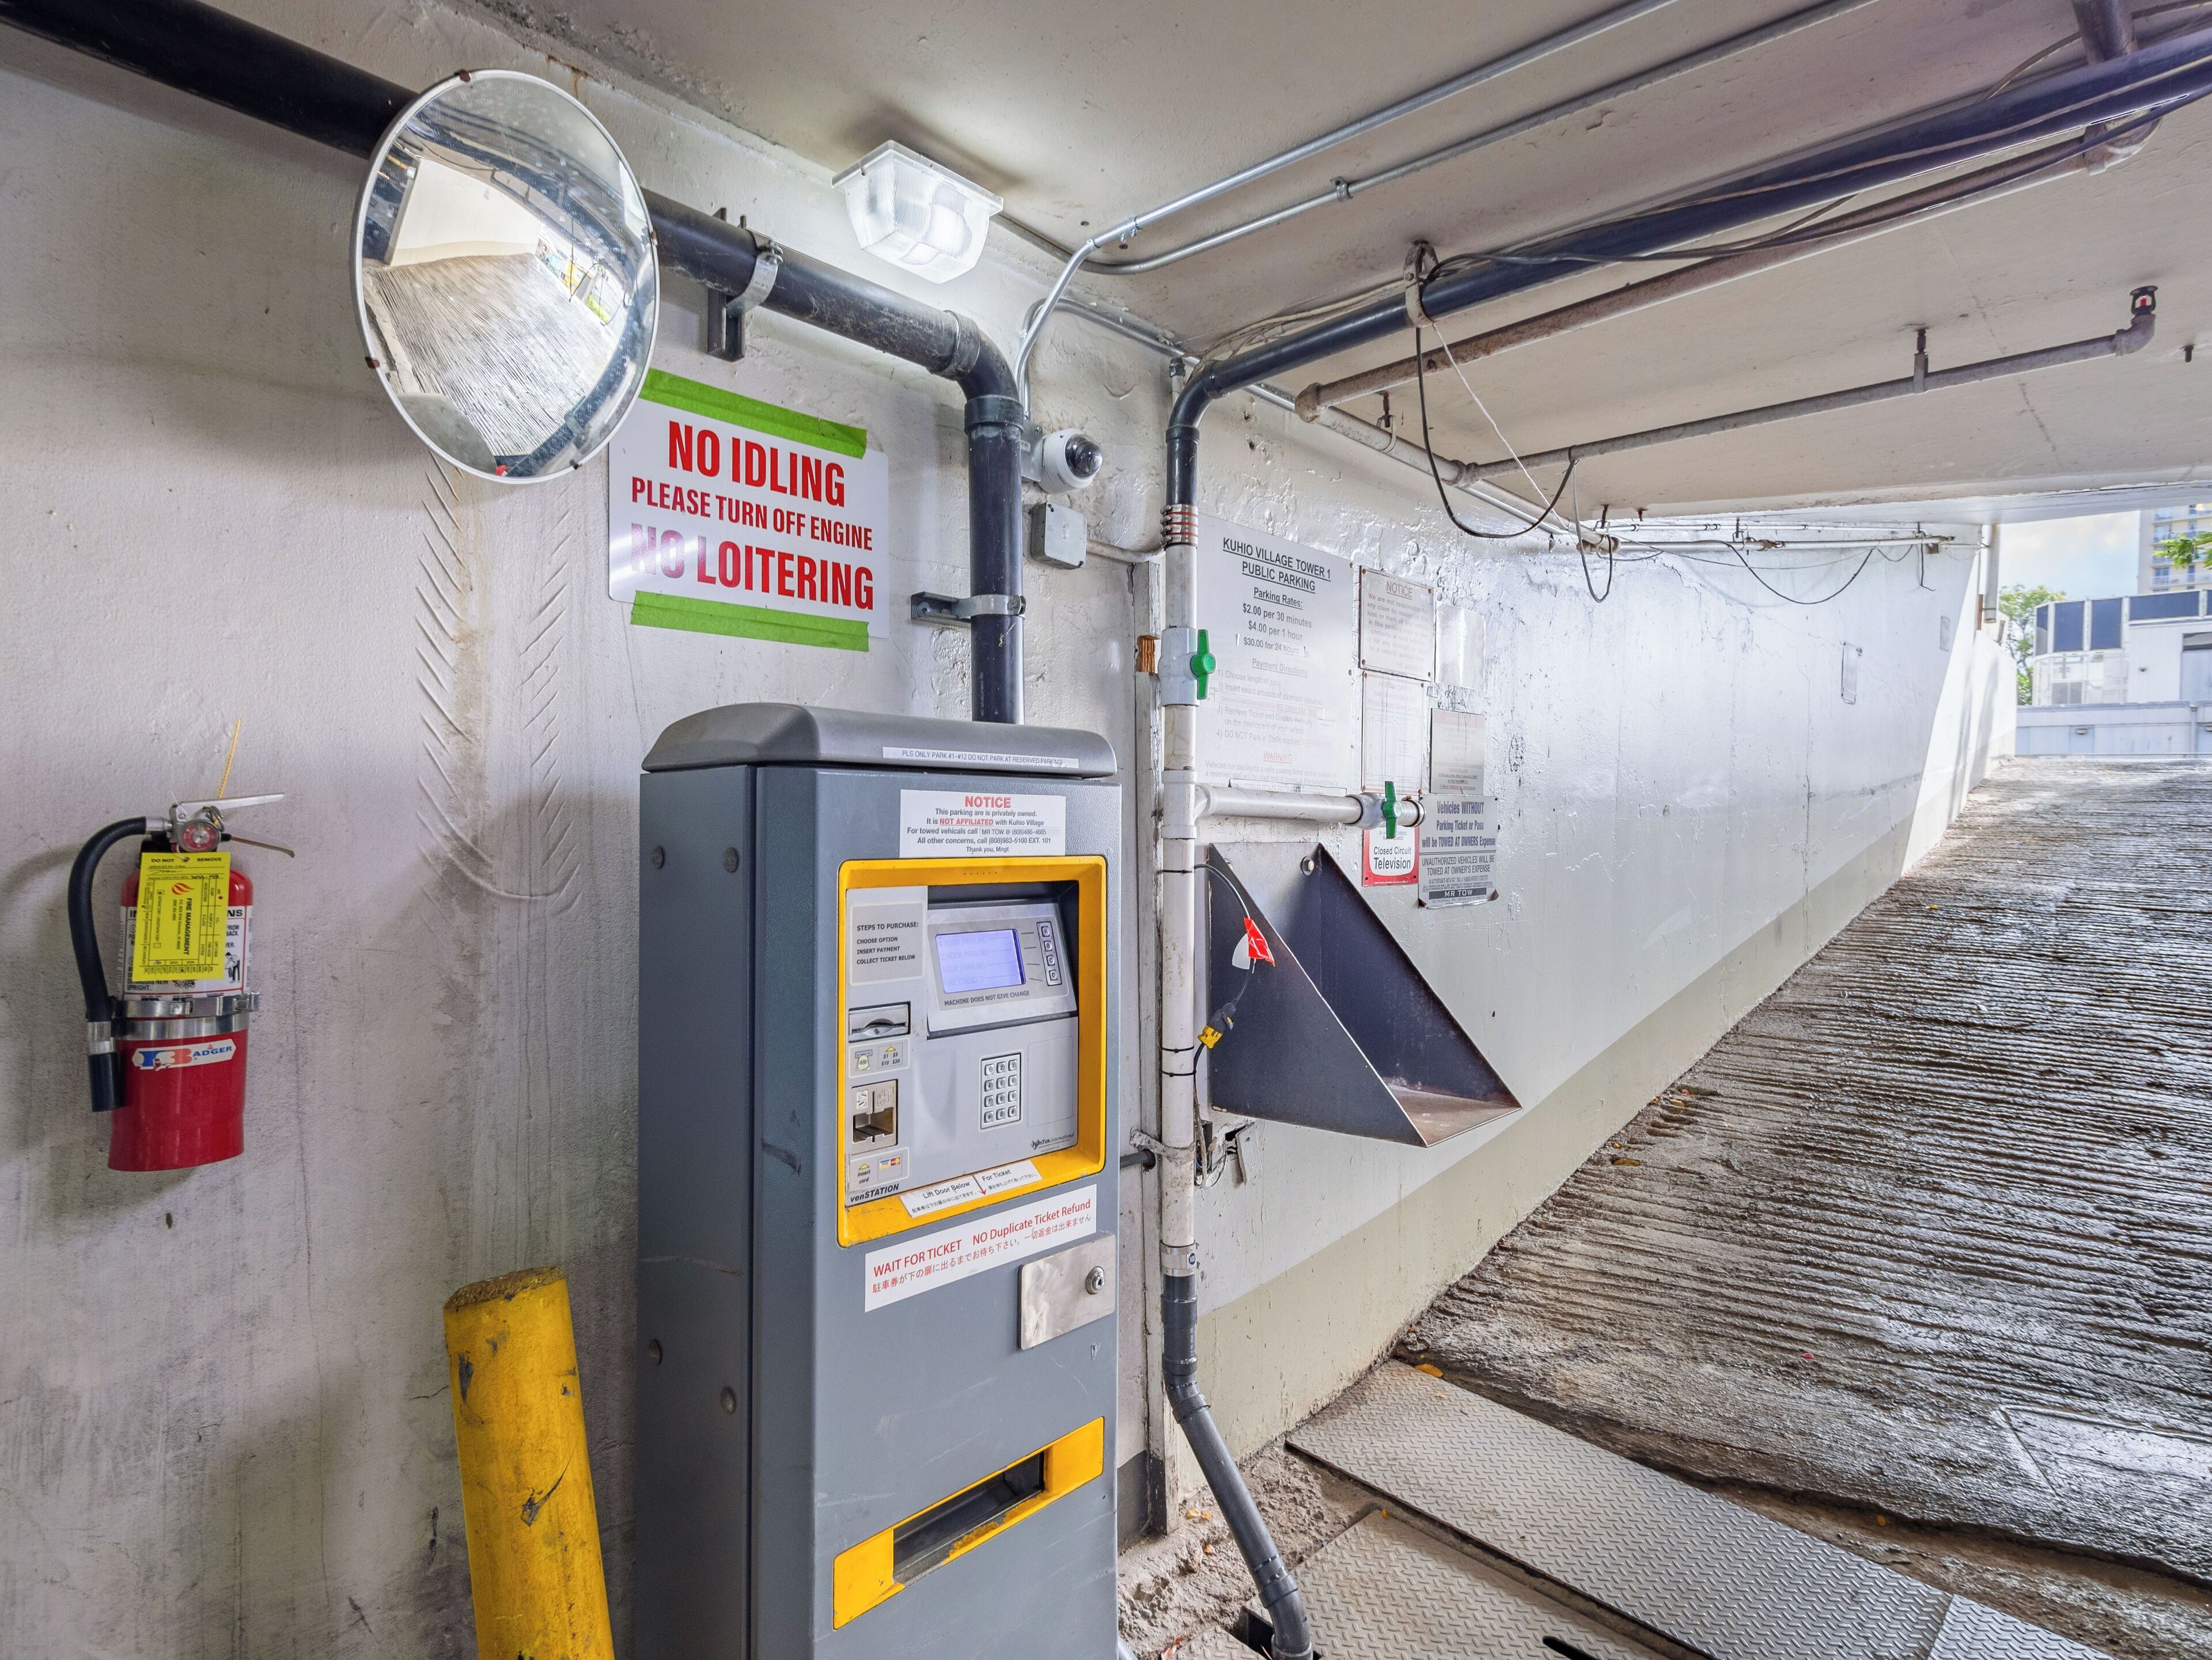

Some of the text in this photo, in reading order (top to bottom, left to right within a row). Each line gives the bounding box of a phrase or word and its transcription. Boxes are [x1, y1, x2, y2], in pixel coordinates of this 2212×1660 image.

[669, 422, 844, 506] NO IDLING
[632, 477, 872, 551] PLEASE TURN OFF ENGINE
[1223, 537, 1330, 579] KUHIO VILLAGE TOWER 1
[631, 523, 873, 609] NO LOITERING
[1242, 561, 1315, 591] PUBLIC PARKING
[1386, 581, 1413, 598] NOTICE
[1254, 587, 1303, 608] Parking Rates:
[1243, 602, 1312, 628] $2.00 per 30 minutes
[1248, 620, 1303, 640] $4.00 per 1 hour
[1243, 636, 1300, 654] $30.00 for 24 hours
[1252, 658, 1308, 676] Payment Directions
[902, 749, 914, 757] PLS
[1263, 752, 1292, 762] WARNING
[965, 795, 1011, 808] NOTICE
[1437, 801, 1484, 814] Vehicles WITHOUT
[949, 809, 973, 817] parking
[991, 810, 1016, 818] privately
[1026, 819, 1044, 827] Village
[1436, 820, 1484, 832] Parking Ticket or Pass
[988, 837, 1028, 845] (808)983-5100
[1422, 836, 1495, 848] will be TOWED AT OWNERS Expense
[1373, 846, 1411, 855] Closed Circuit
[1373, 857, 1411, 869] Television
[1422, 855, 1495, 866] UNAUTHORIZED VEHICLES WILL BE
[1427, 864, 1490, 876] TOWED AT OWNER'S EXPENSE
[184, 912, 192, 955] MANAGEMENT
[944, 998, 969, 1006] MACHINE
[993, 1169, 1012, 1179] Ticket
[850, 1184, 899, 1202] venSTATION
[934, 1187, 950, 1195] Door
[950, 1182, 970, 1191] Below
[873, 1199, 1090, 1277] WAIT FOR TICKET NO Duplicate Ticket Refund
